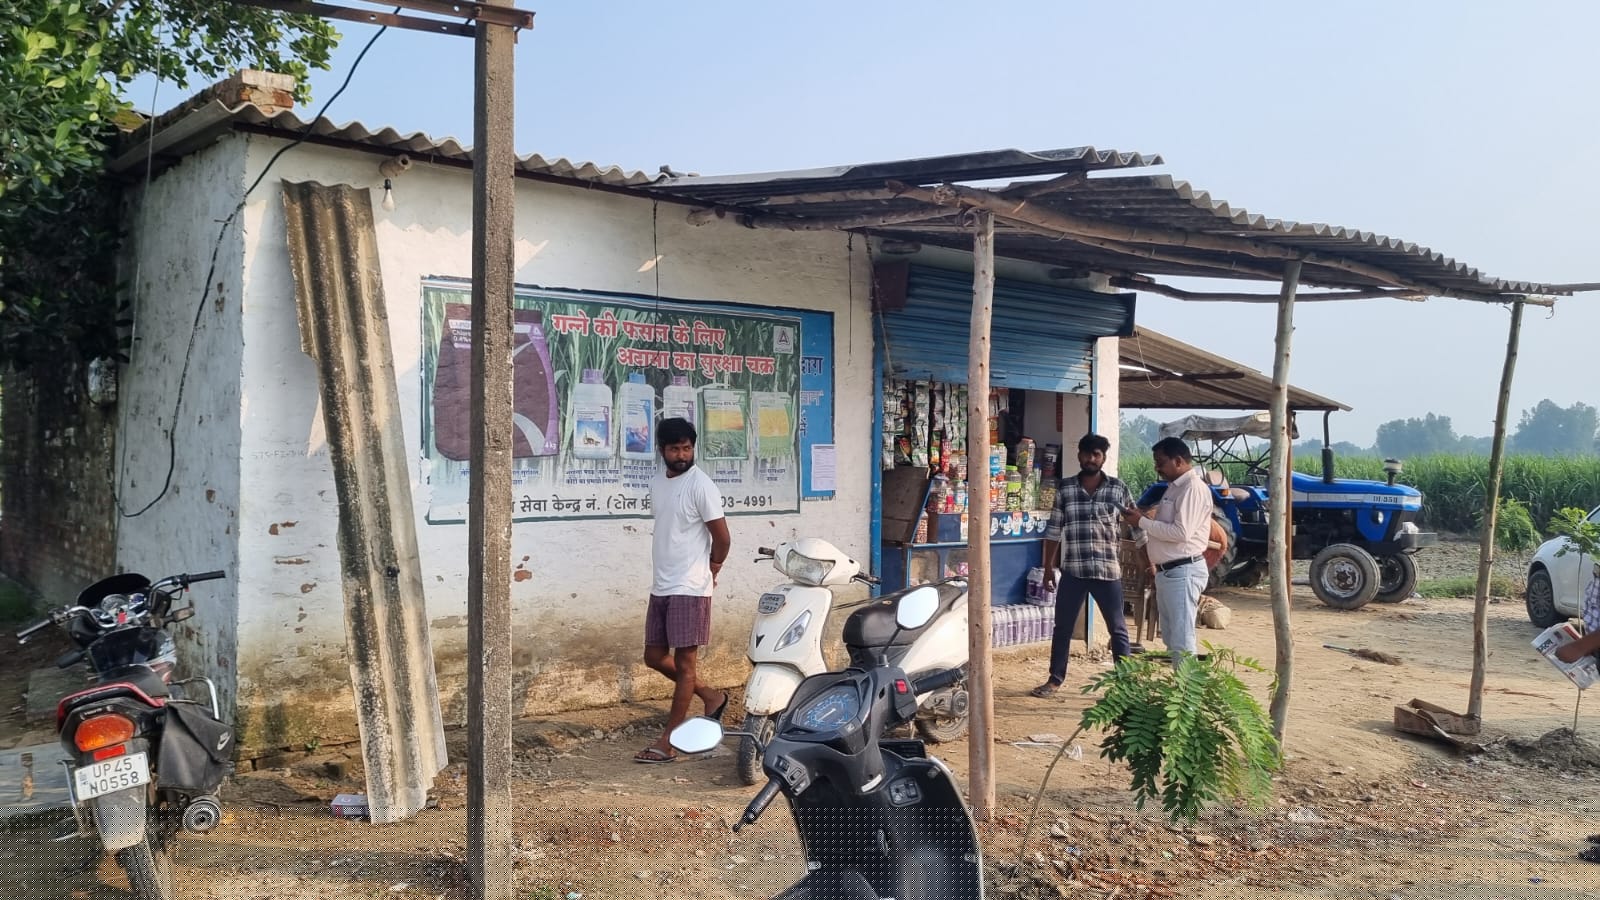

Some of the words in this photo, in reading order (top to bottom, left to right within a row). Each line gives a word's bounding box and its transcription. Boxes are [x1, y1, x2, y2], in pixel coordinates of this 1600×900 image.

[552, 309, 589, 336] गन्ने
[593, 310, 618, 338] की
[622, 321, 669, 343] फसल
[672, 318, 690, 344] के
[692, 320, 726, 350] लिए
[672, 351, 696, 371] का
[699, 351, 743, 379] सुरक्षा
[745, 356, 776, 375] चक्र
[520, 494, 547, 512] सेवा
[552, 494, 582, 512] केन्द्र
[93, 757, 132, 778] UP45
[90, 771, 140, 795] N0558
